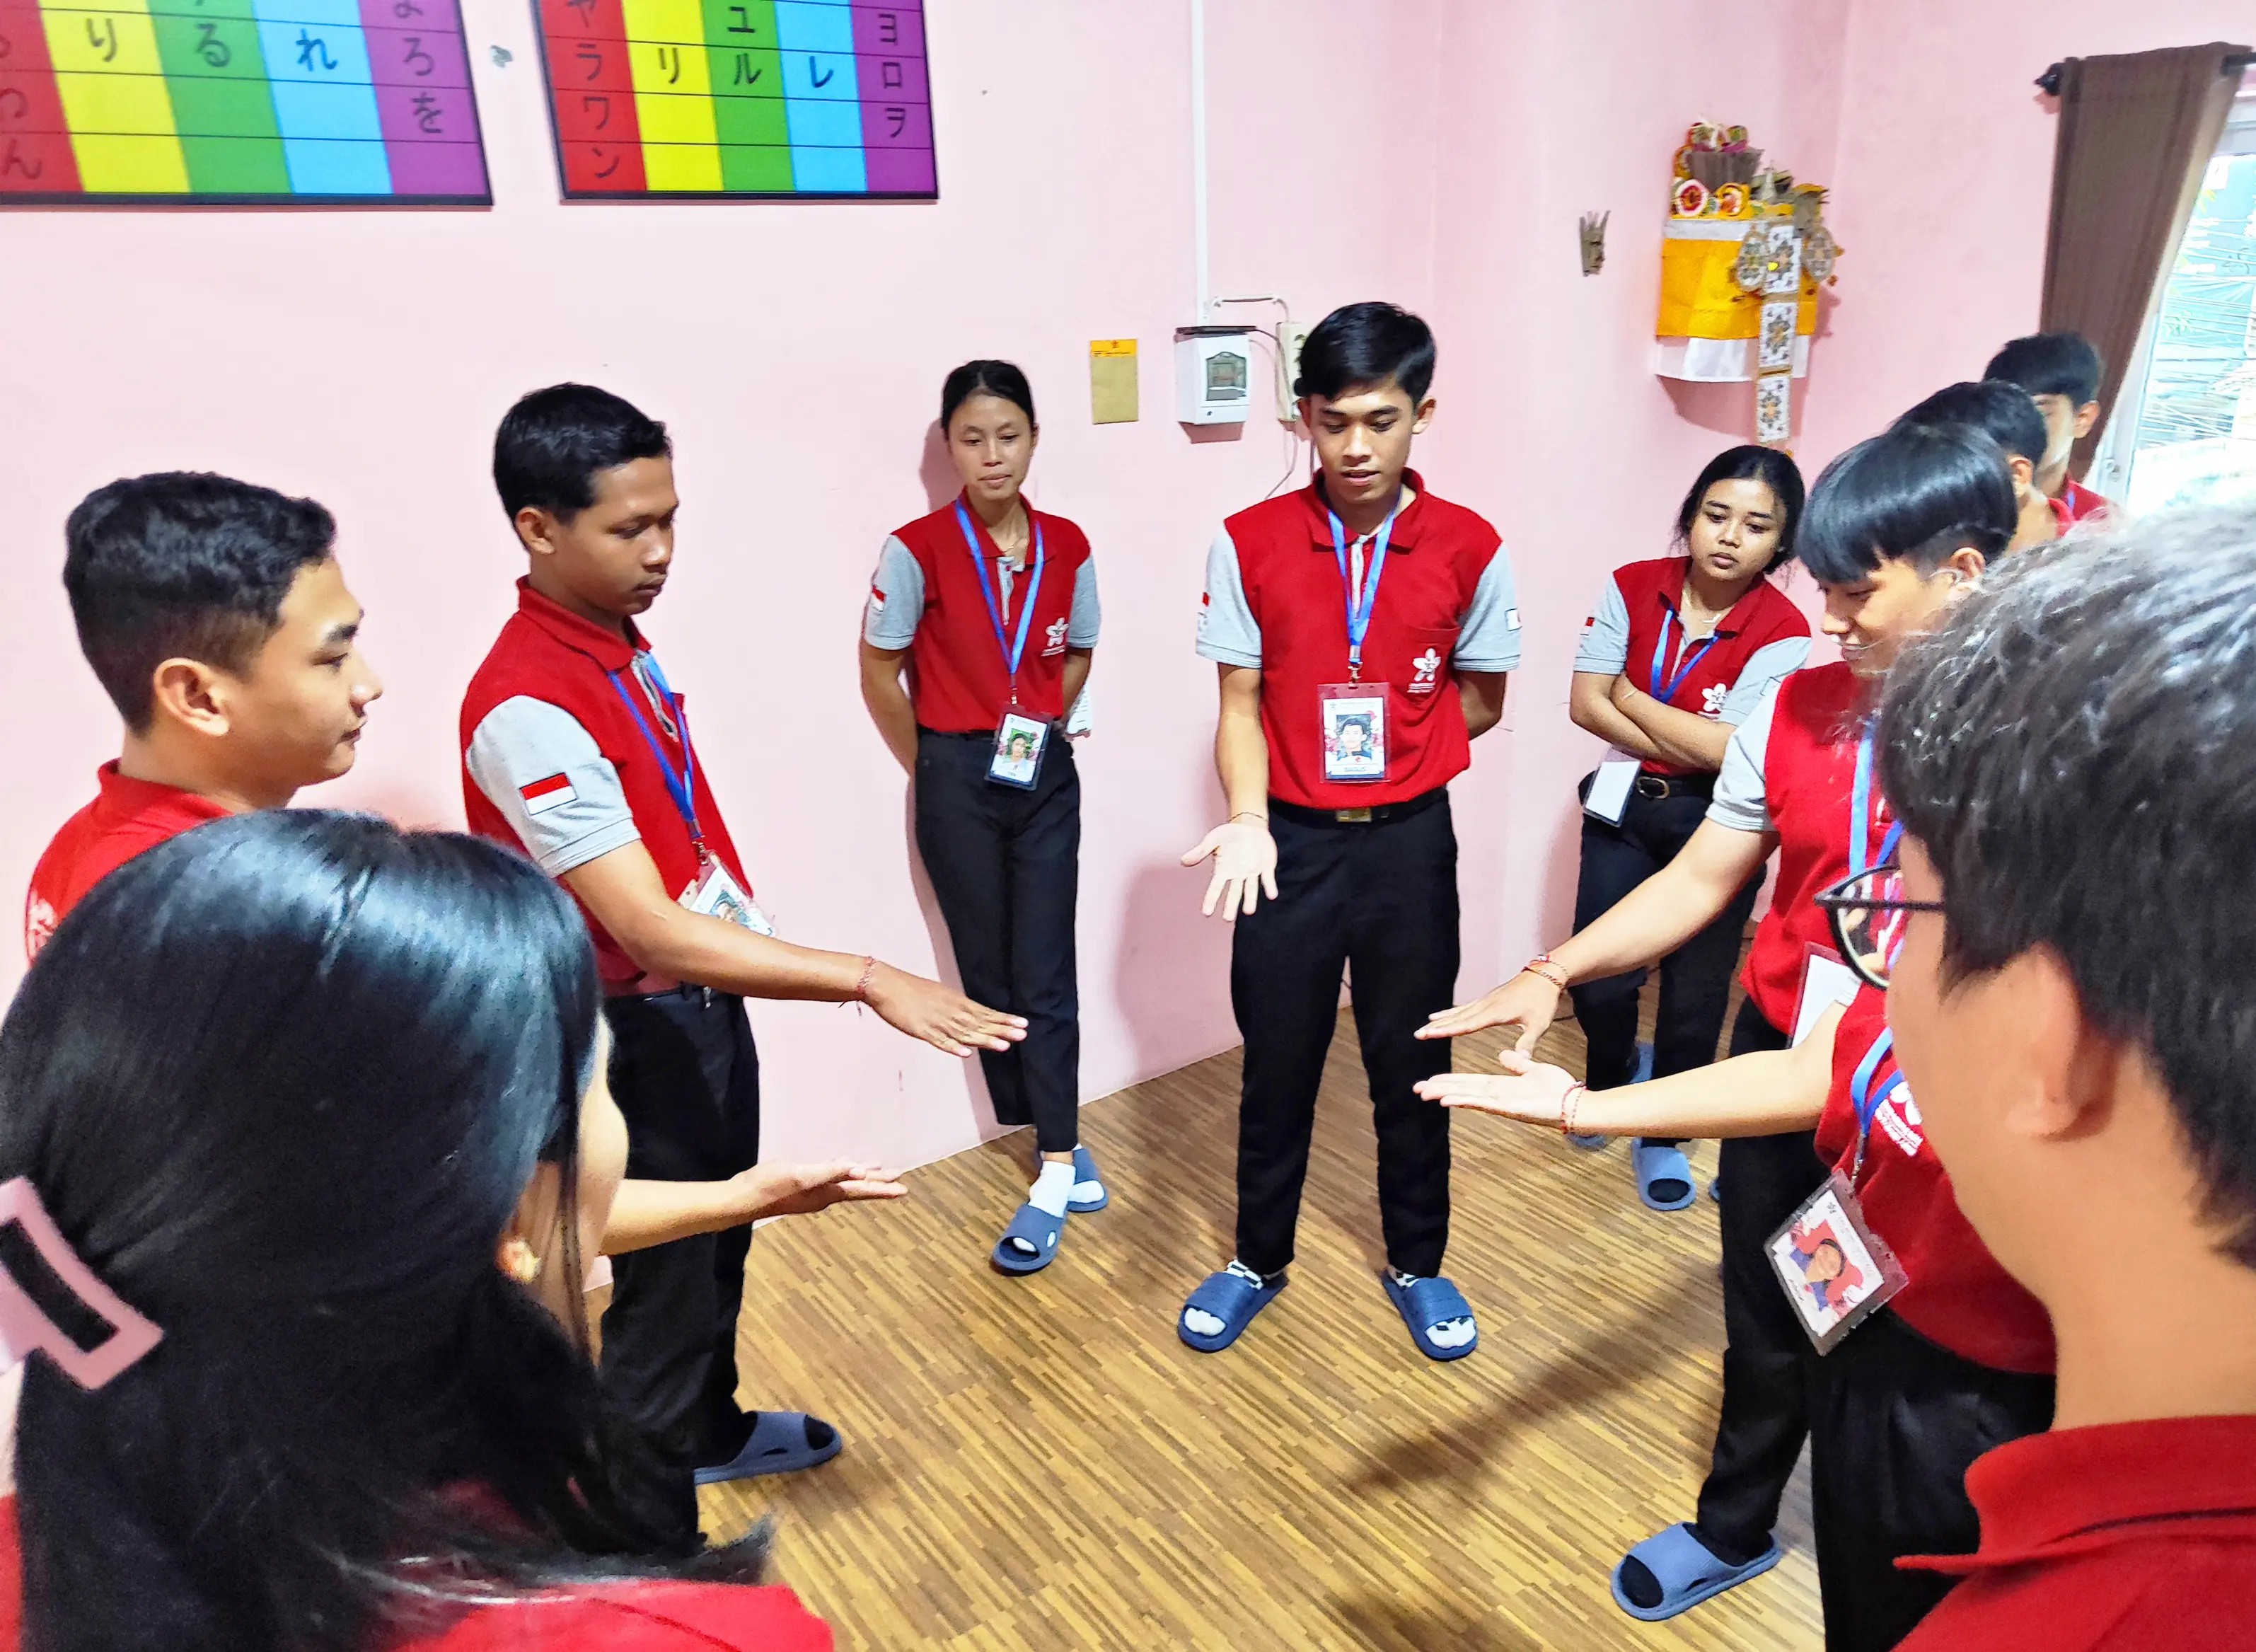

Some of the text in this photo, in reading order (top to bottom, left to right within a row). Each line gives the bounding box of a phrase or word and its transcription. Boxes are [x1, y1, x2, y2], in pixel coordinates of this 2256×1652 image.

[86, 18, 435, 76] り る れ ろ
[727, 6, 756, 33] ユ
[879, 13, 898, 46] ヨ
[575, 42, 902, 88] ラ リ ル レ ロ
[411, 91, 444, 134] を
[583, 96, 906, 138] ワ ヲ
[1, 139, 42, 180] ん
[591, 146, 620, 178] ン
